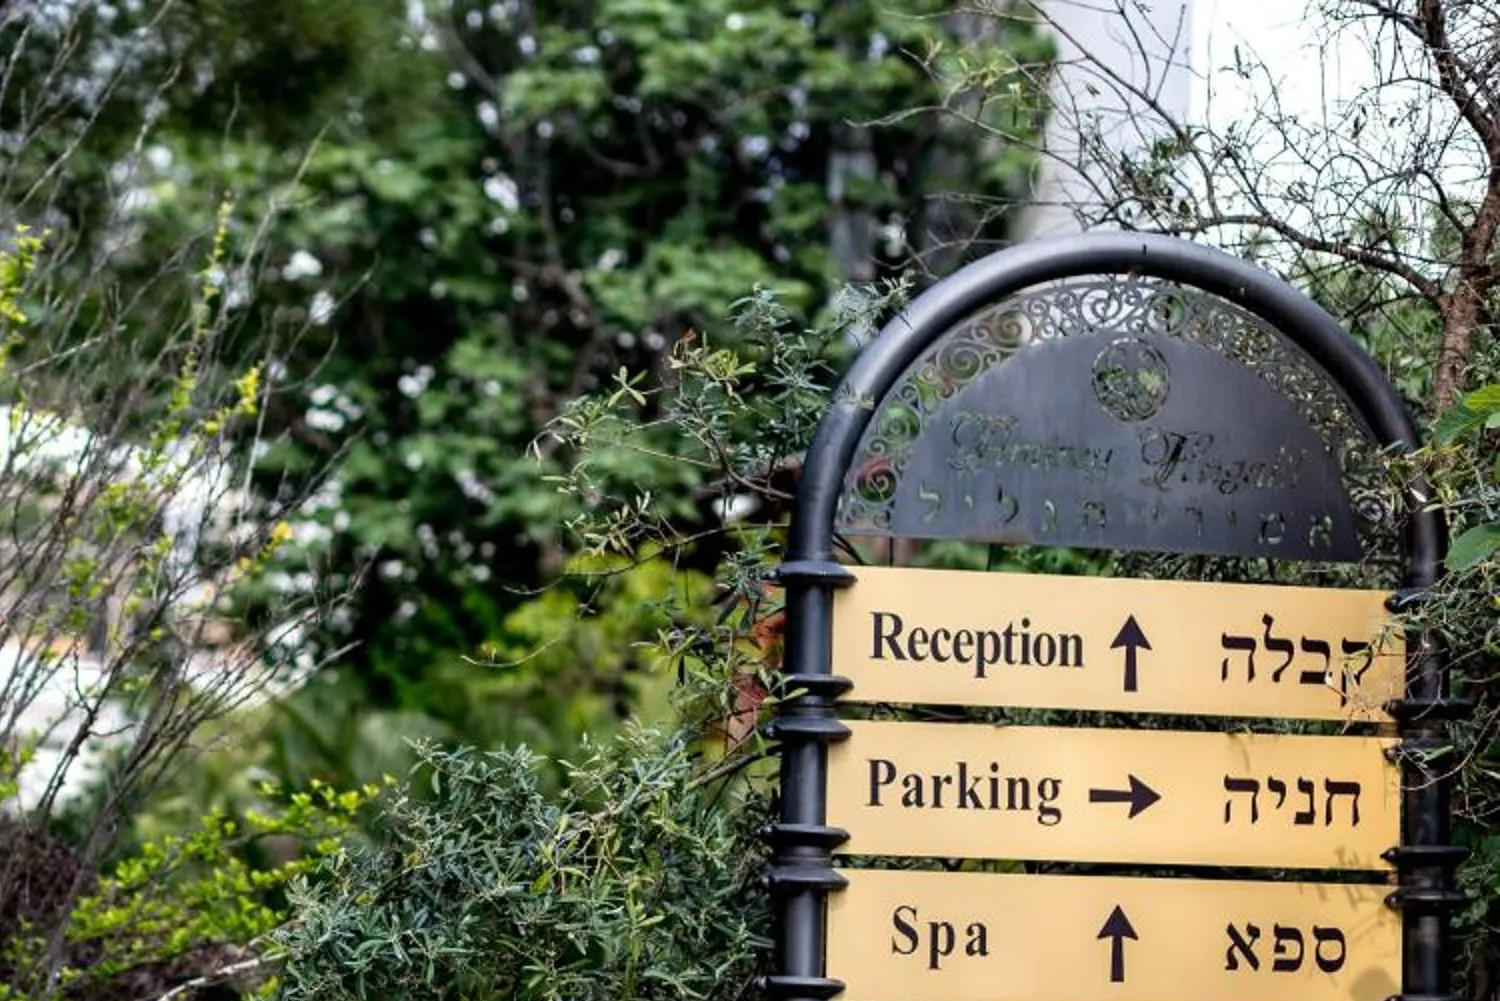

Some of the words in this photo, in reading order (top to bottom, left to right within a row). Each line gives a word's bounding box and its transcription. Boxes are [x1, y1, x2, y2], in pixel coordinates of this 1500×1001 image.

[870, 611, 1084, 679] Reception
[1221, 613, 1375, 707] קבלה
[867, 759, 1062, 827] Parking
[1223, 774, 1362, 827] חניה
[891, 905, 990, 971] Spa
[1224, 922, 1347, 974] ספא
